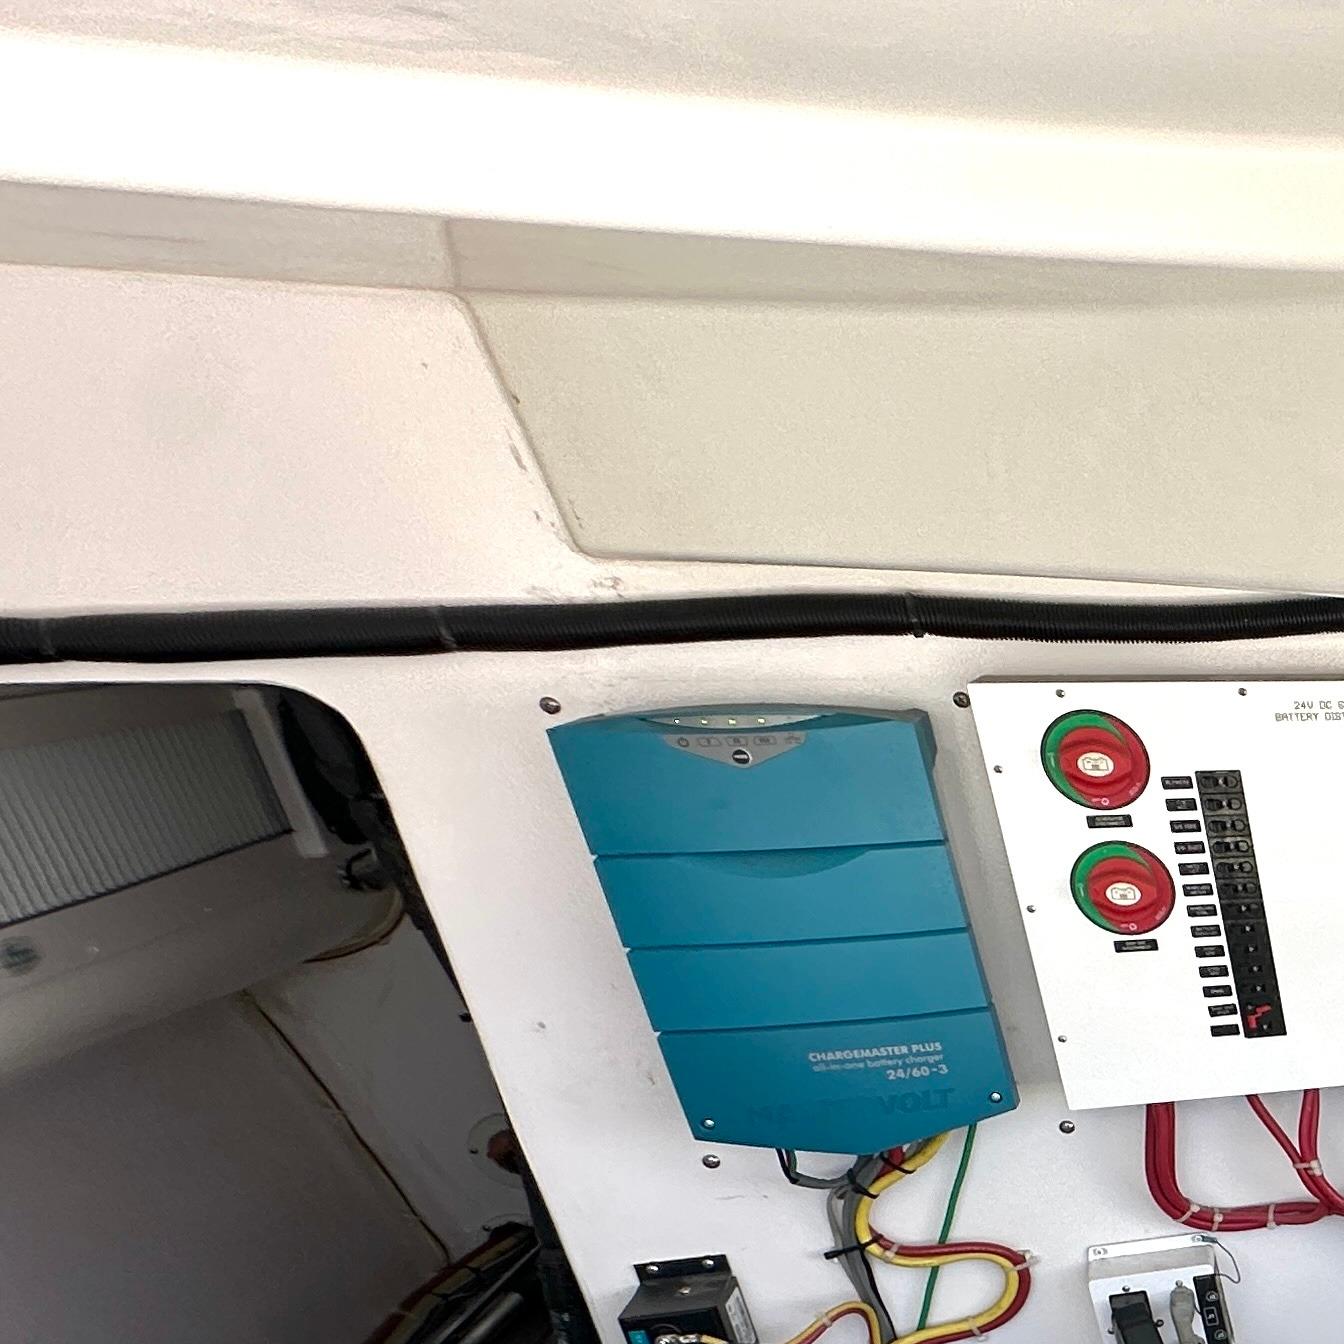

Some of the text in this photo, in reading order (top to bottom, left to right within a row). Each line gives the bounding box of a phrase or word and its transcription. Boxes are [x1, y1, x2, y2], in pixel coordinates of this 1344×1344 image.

[1294, 701, 1313, 710] 24V
[1319, 701, 1332, 709] DC
[1275, 712, 1319, 722] BATTERY
[808, 1042, 942, 1062] CHARGEMASTER PLUS
[886, 1064, 949, 1081] 24/60-3
